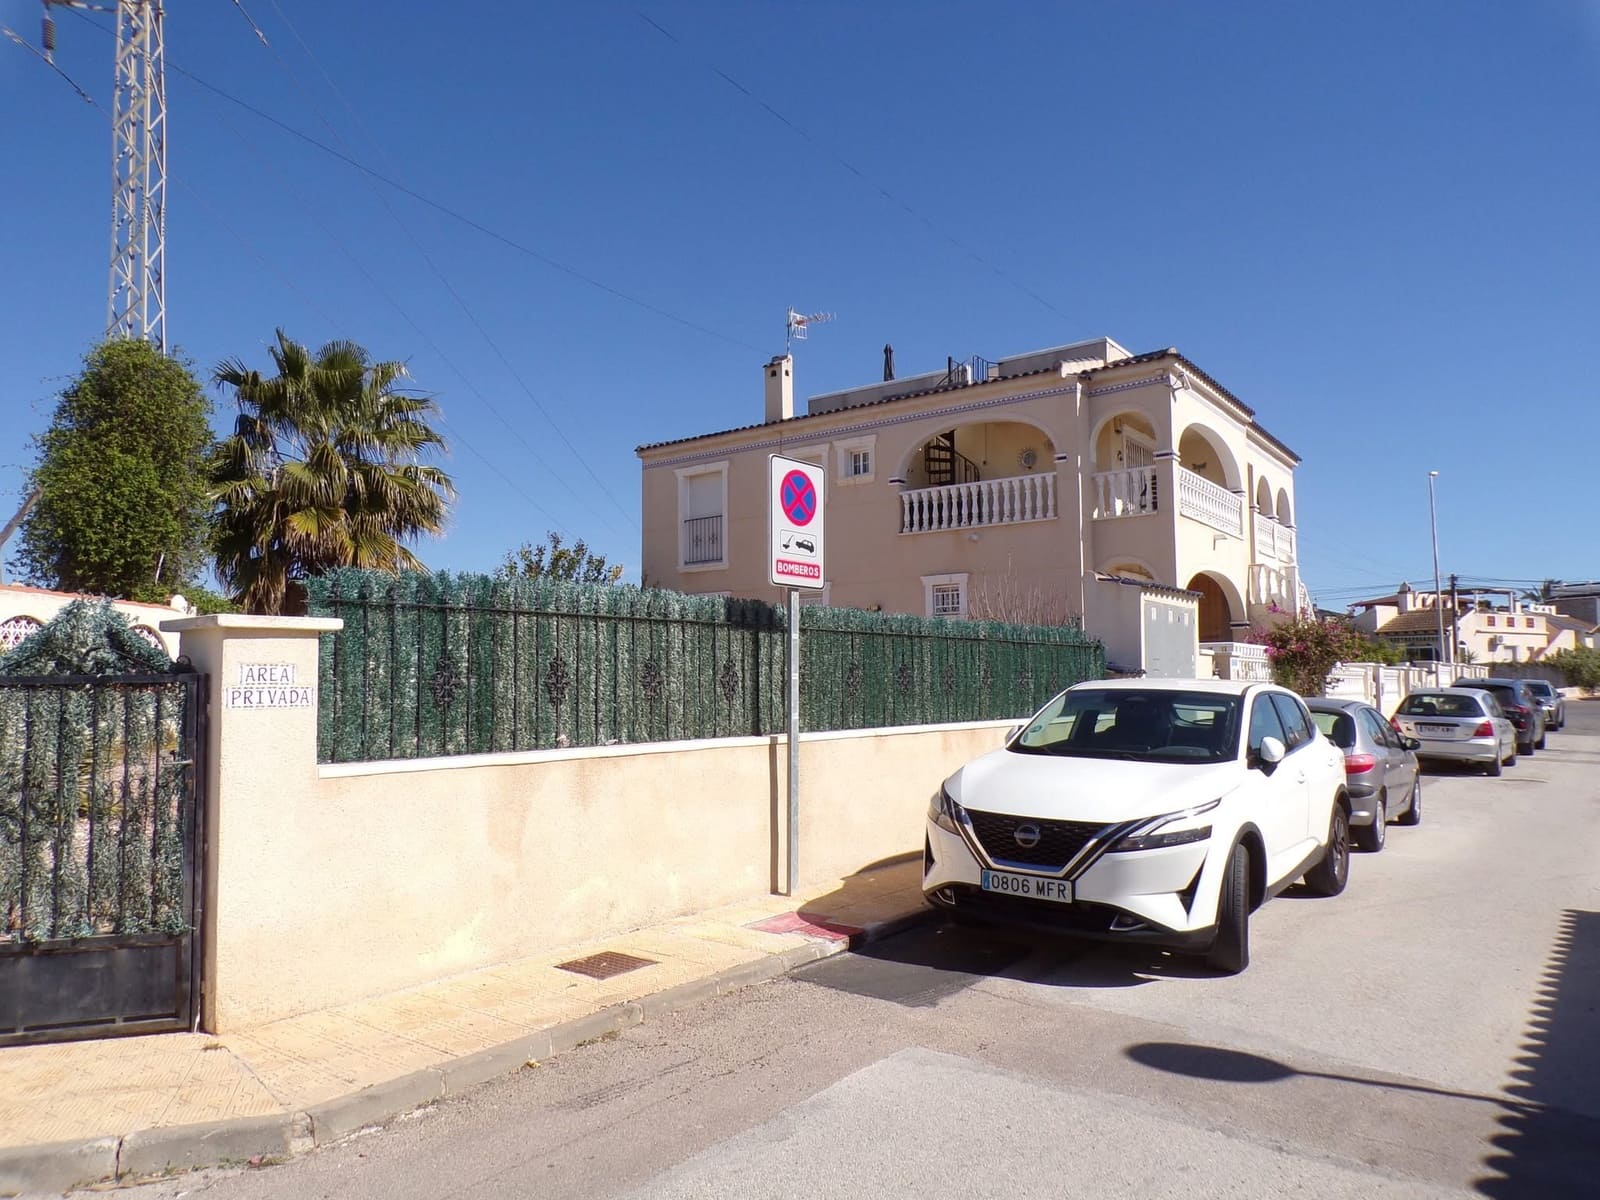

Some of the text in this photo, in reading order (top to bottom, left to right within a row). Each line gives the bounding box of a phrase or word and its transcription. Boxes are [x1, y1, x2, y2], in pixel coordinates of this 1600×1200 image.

[777, 562, 819, 577] BOMBEROS
[245, 667, 290, 682] AREA
[231, 690, 310, 705] PRIVADA
[991, 875, 1066, 899] 0806 MFR
